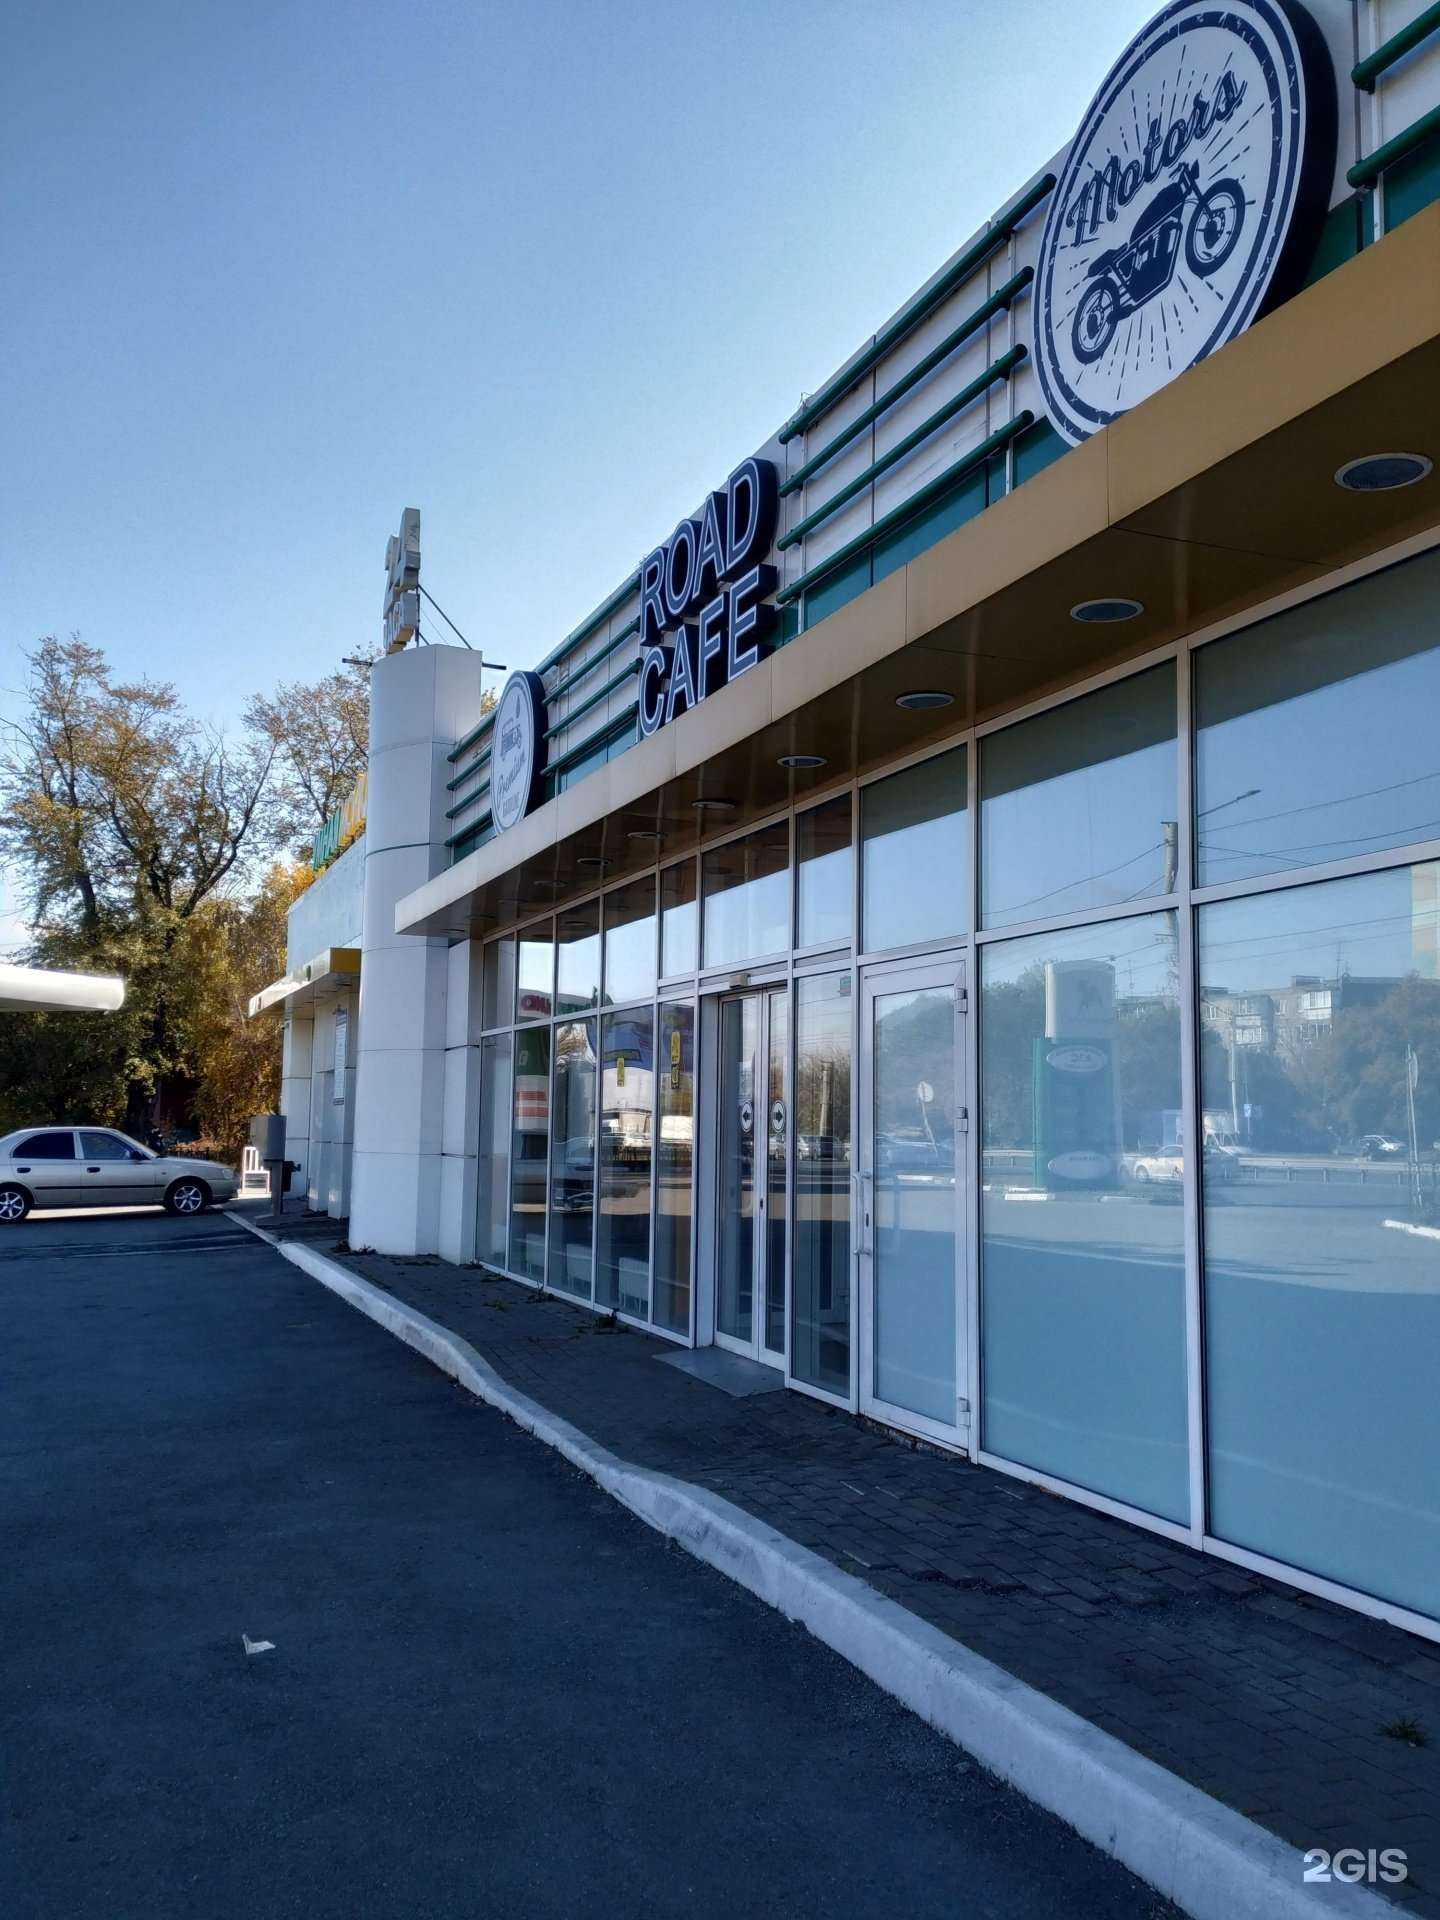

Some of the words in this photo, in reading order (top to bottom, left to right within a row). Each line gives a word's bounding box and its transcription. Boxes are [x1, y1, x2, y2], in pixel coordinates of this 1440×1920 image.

[1062, 71, 1247, 248] Motors
[639, 457, 777, 647] ROAD
[639, 564, 774, 736] CAFE
